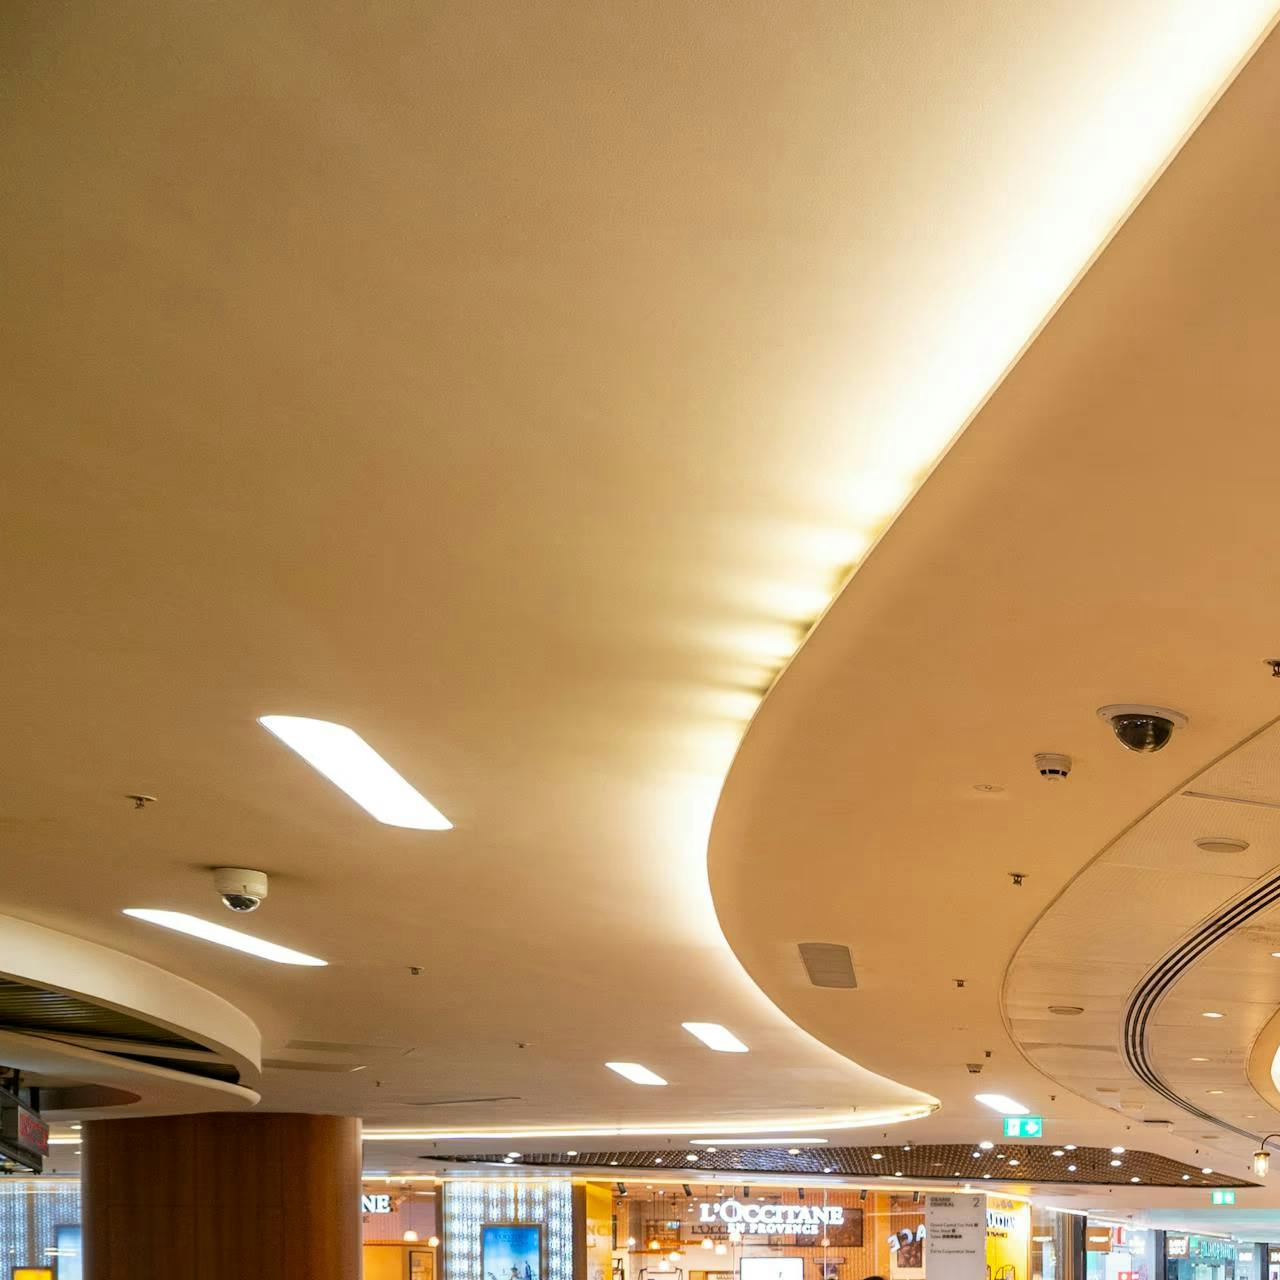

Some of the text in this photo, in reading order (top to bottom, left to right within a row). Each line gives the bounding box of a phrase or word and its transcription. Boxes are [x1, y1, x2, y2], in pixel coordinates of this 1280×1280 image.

[972, 1197, 980, 1208] 2
[700, 1201, 844, 1224] L'OCCITANE
[728, 1222, 819, 1234] EN PROVENCE
